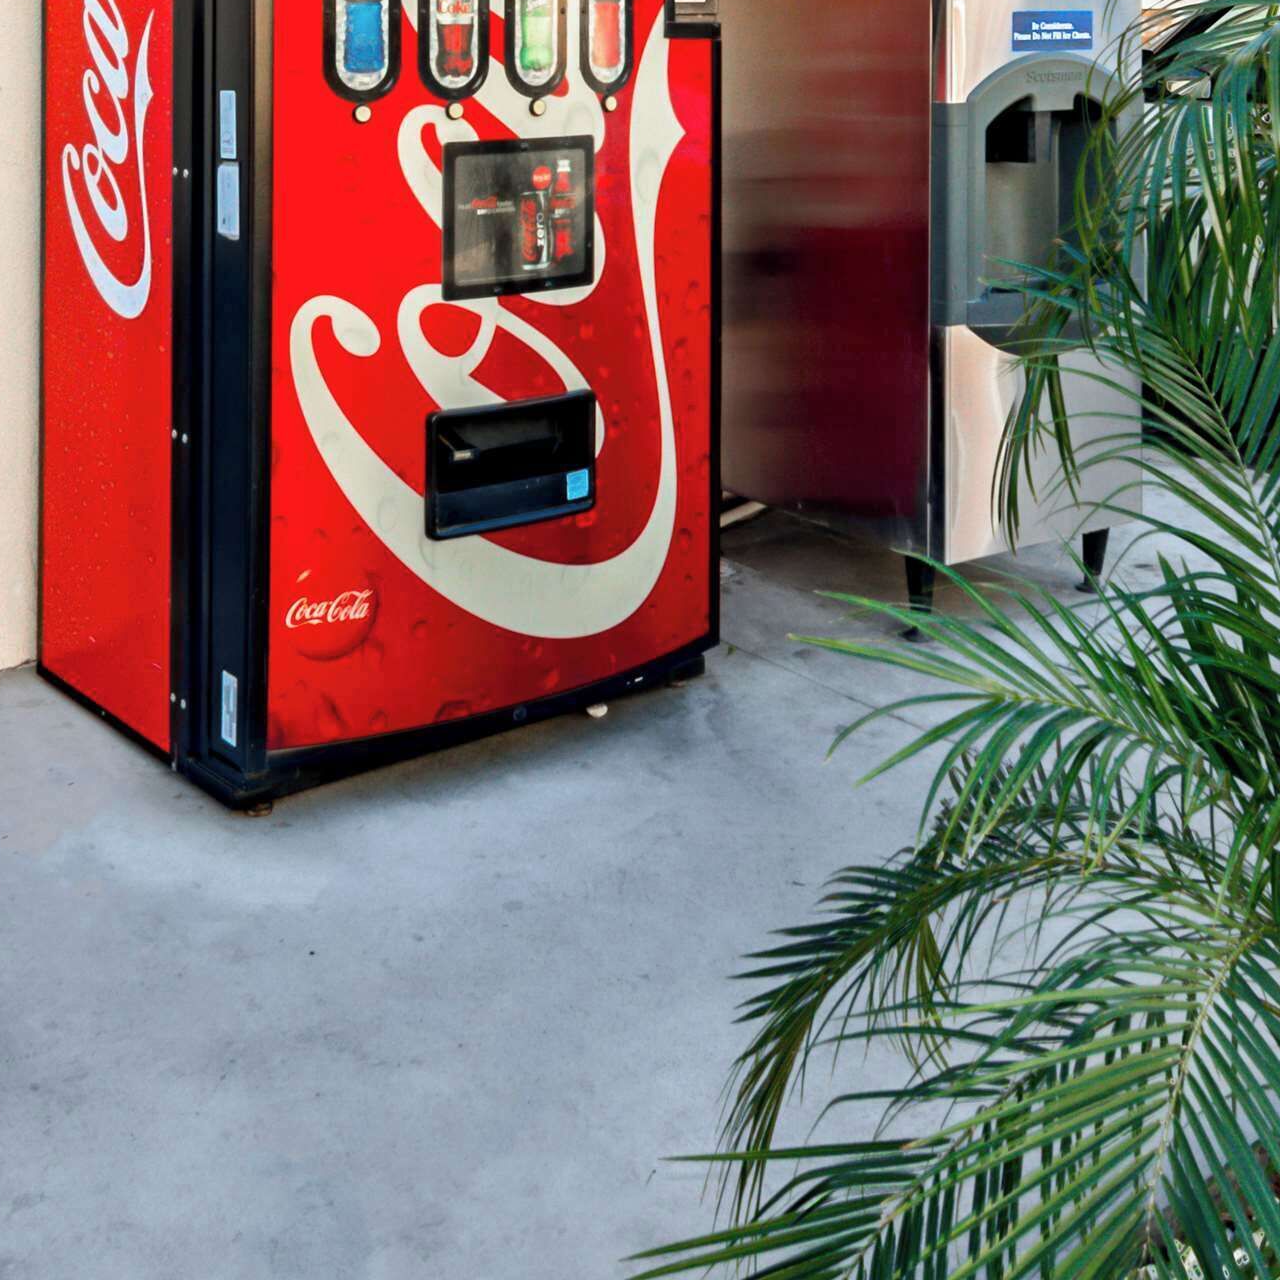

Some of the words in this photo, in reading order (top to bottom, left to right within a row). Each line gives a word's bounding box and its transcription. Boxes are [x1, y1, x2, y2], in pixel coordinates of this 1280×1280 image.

[438, 0, 471, 14] Coke
[536, 212, 545, 247] zero
[285, 589, 374, 629] Coca-Cola
